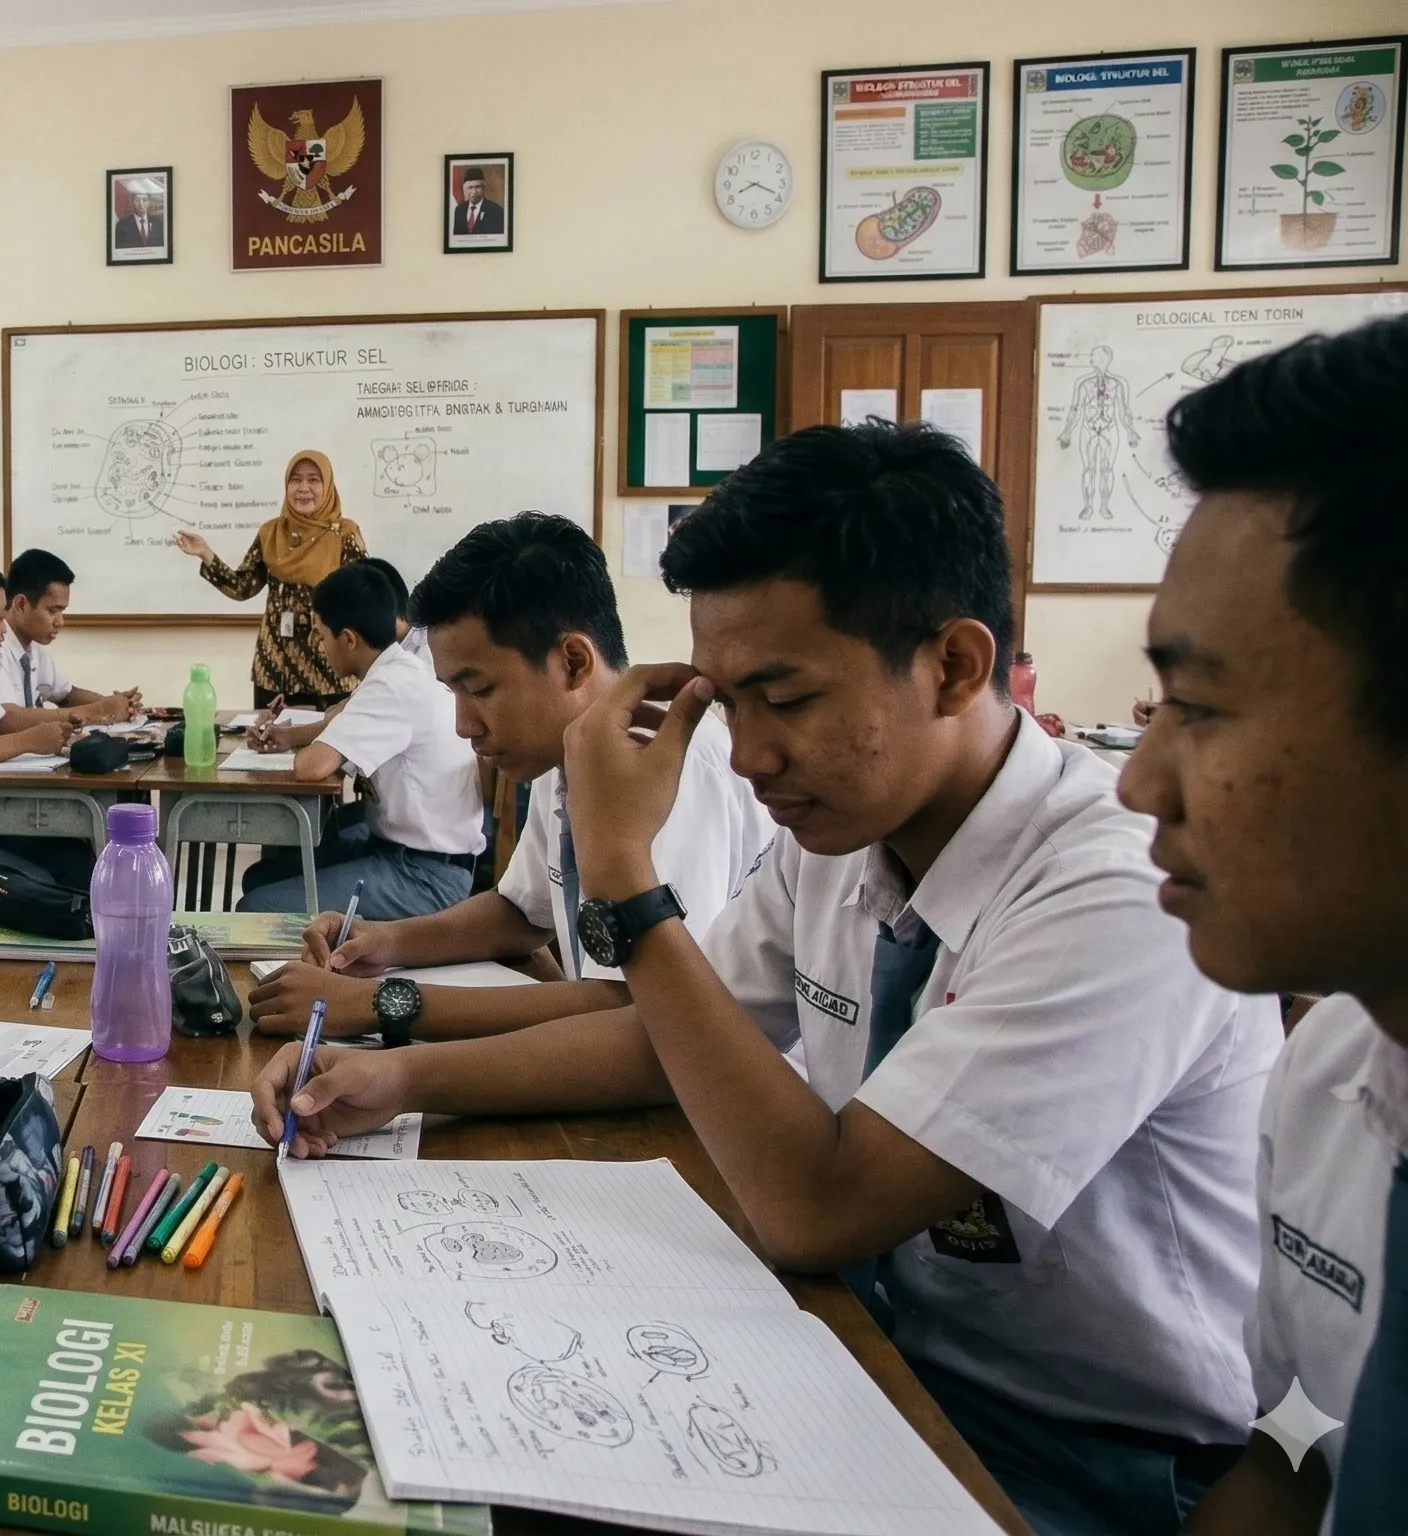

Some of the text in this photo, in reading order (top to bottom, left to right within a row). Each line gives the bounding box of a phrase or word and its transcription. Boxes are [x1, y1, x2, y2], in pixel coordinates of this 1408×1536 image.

[737, 153, 746, 165] 11
[776, 162, 784, 174] 2
[723, 180, 732, 191] 9
[778, 178, 786, 189] 3
[774, 192, 783, 204] 4
[738, 205, 745, 216] 7
[750, 209, 759, 220] 6
[764, 203, 772, 216] 5
[248, 232, 367, 256] PANCASILA
[263, 350, 348, 368] STRUKTUR
[357, 349, 387, 365] SEL
[494, 401, 504, 415] &
[15, 1318, 114, 1456] BIOLOGI
[91, 1341, 148, 1436] KELAS XI
[7, 1491, 89, 1522] BIOLOGI
